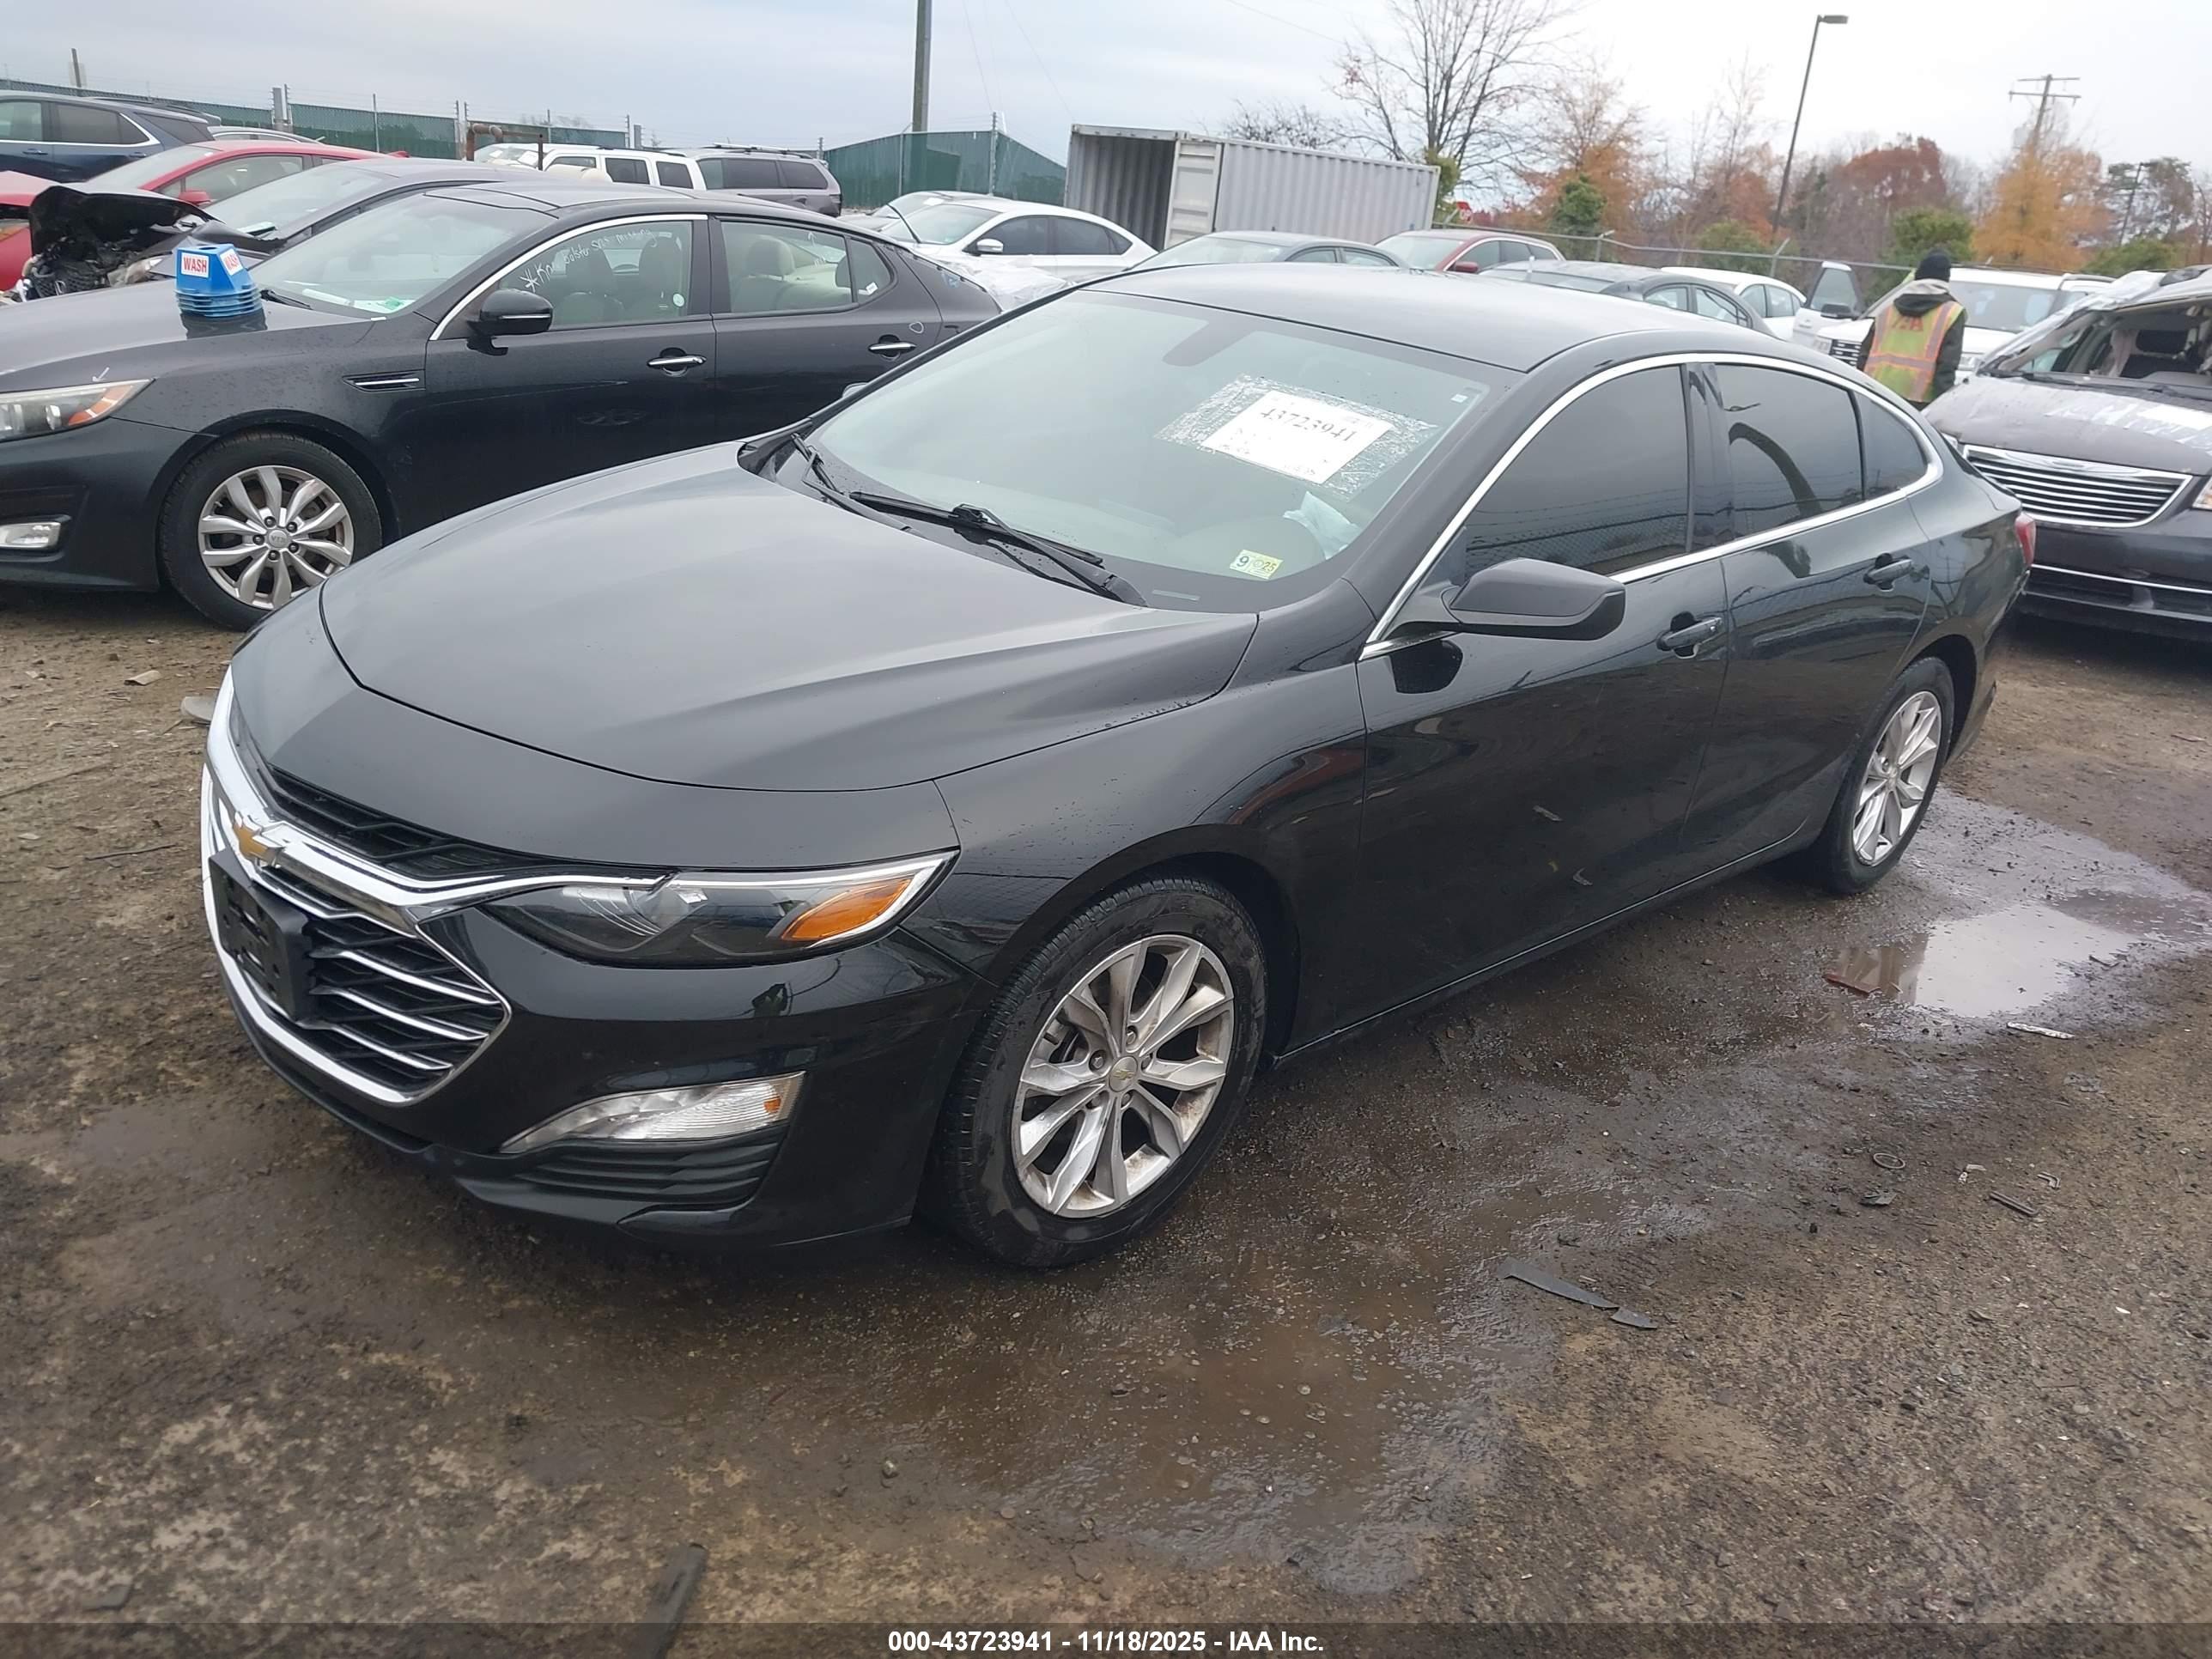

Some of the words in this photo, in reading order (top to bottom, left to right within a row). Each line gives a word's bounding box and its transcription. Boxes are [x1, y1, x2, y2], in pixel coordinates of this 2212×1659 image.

[183, 256, 208, 273] WASH
[1260, 407, 1358, 442] 43723941
[1236, 556, 1249, 567] 9
[1262, 562, 1278, 572] 25
